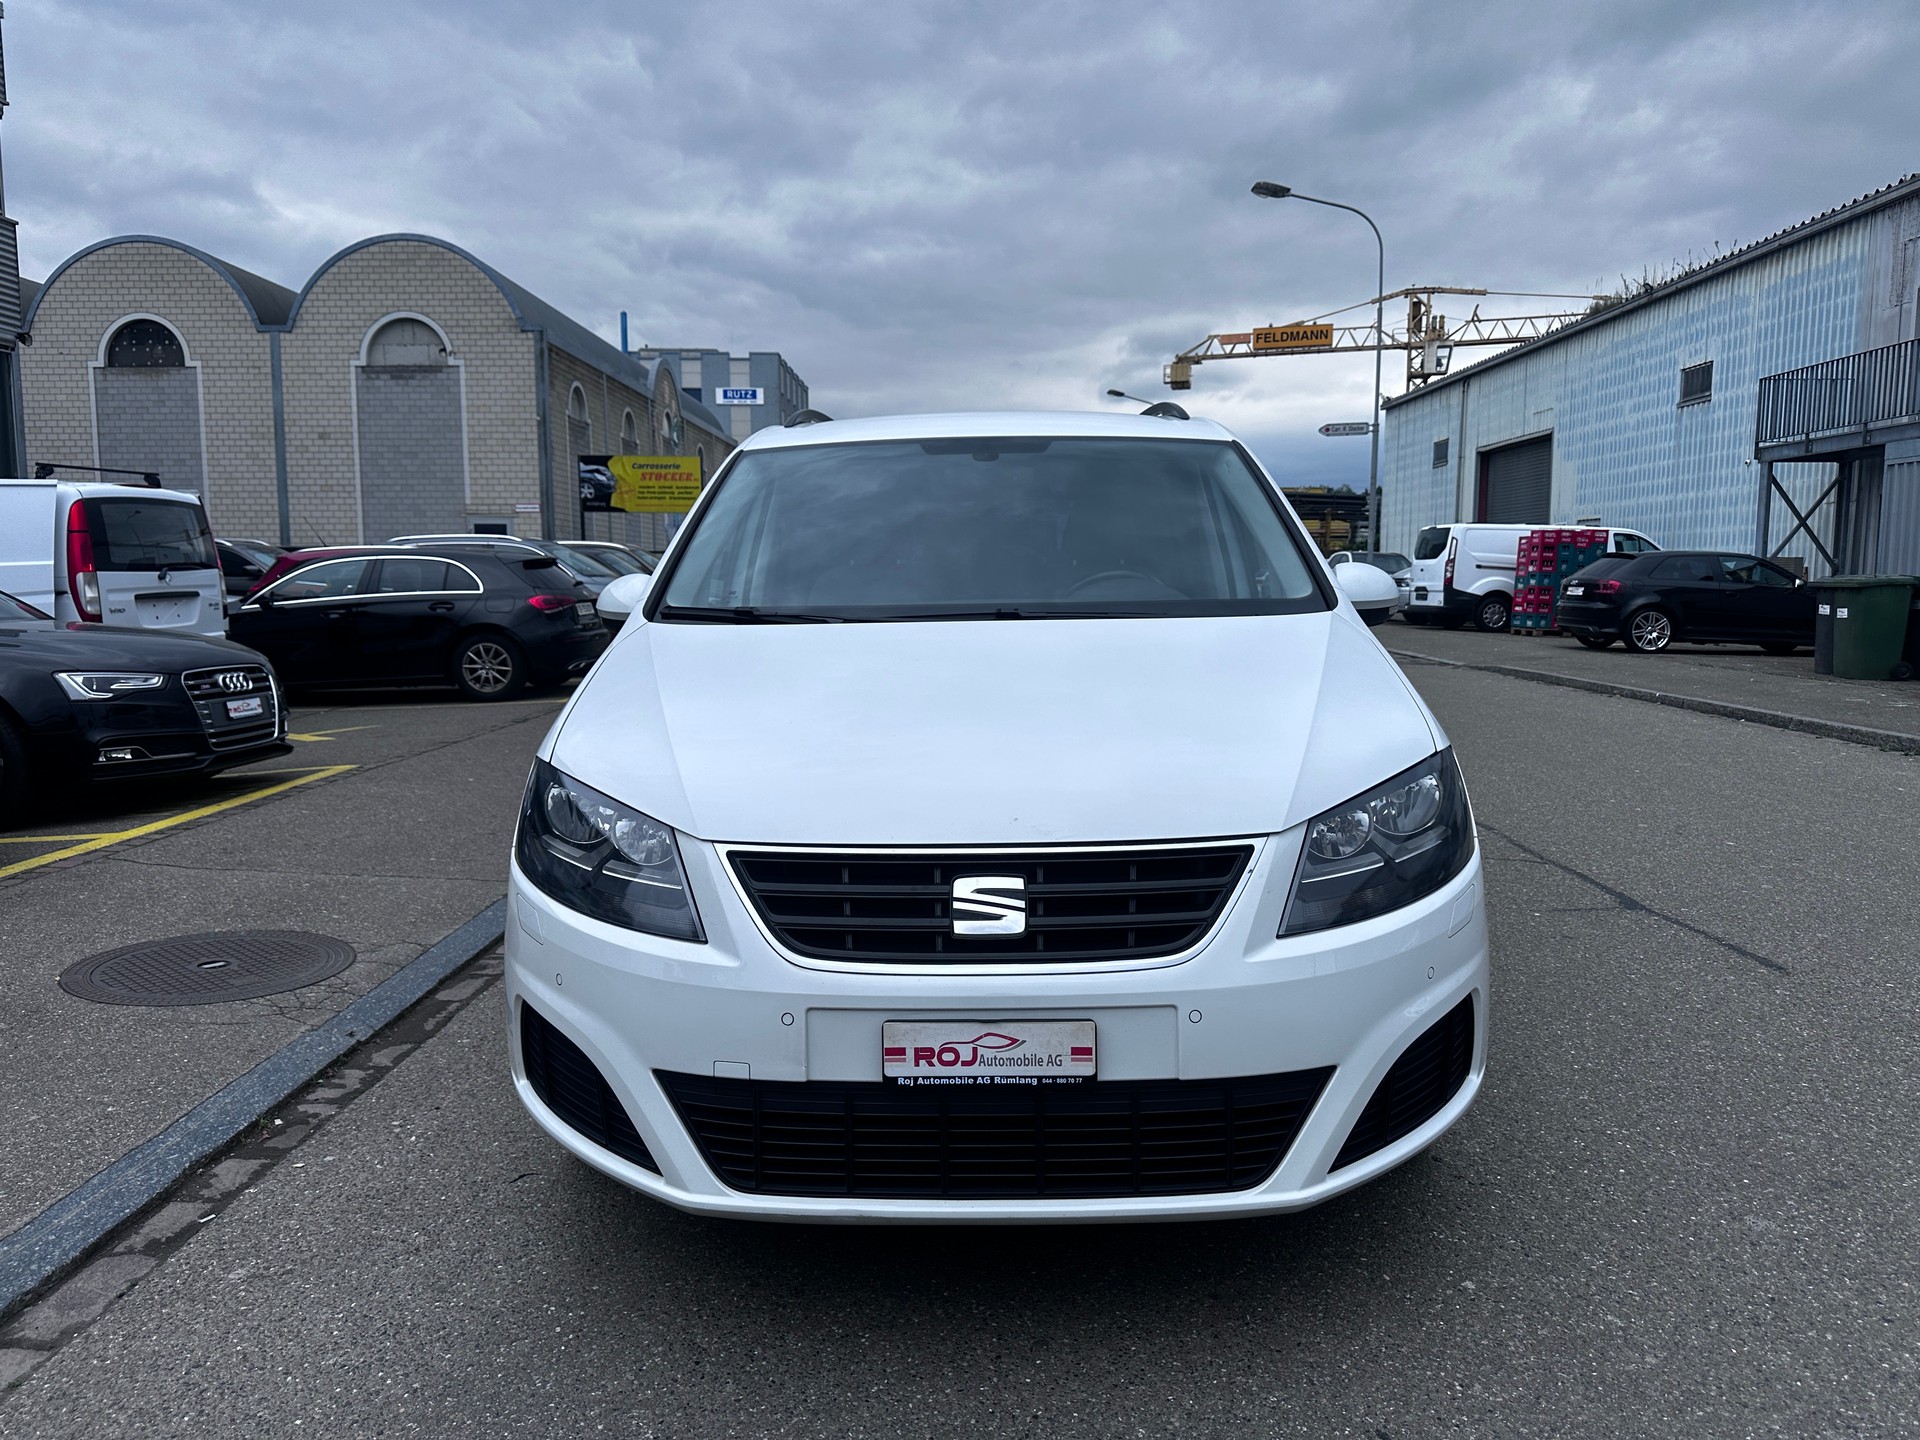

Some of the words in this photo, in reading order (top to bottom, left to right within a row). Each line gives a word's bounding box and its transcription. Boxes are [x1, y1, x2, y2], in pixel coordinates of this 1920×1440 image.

[1255, 329, 1329, 344] FELDMANN
[726, 390, 753, 399] RUTZ
[632, 462, 681, 470] Carrosserie
[640, 472, 694, 481] STOCKER
[913, 1046, 978, 1067] ROJ
[978, 1053, 1044, 1067] Automobile
[1046, 1054, 1063, 1067] AG
[897, 1077, 914, 1086] Roj
[917, 1077, 974, 1085] Automobile
[994, 1076, 1038, 1086] Rümlang
